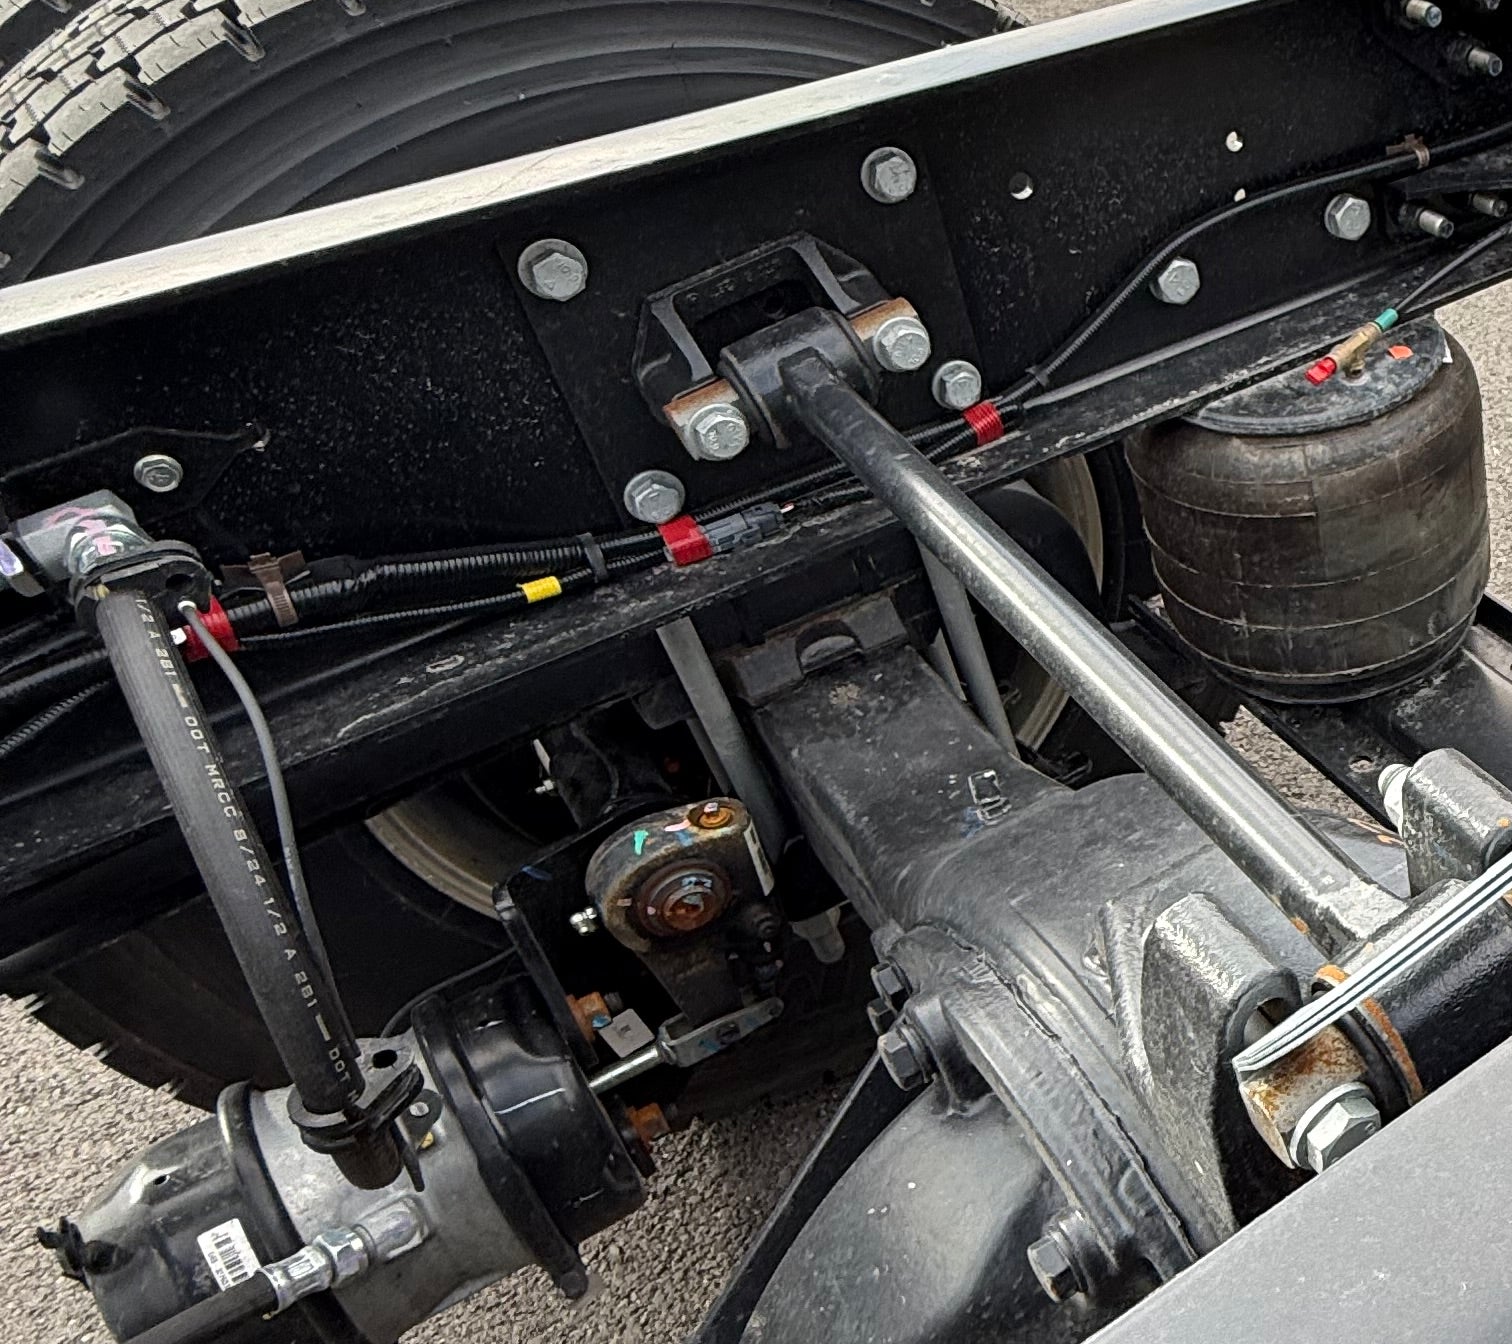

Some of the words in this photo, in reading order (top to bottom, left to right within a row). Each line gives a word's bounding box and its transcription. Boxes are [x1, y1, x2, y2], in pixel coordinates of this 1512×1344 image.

[204, 763, 238, 819] MRCC
[262, 897, 287, 936] 1/2
[284, 948, 297, 961] A
[328, 1047, 350, 1083] DOT
